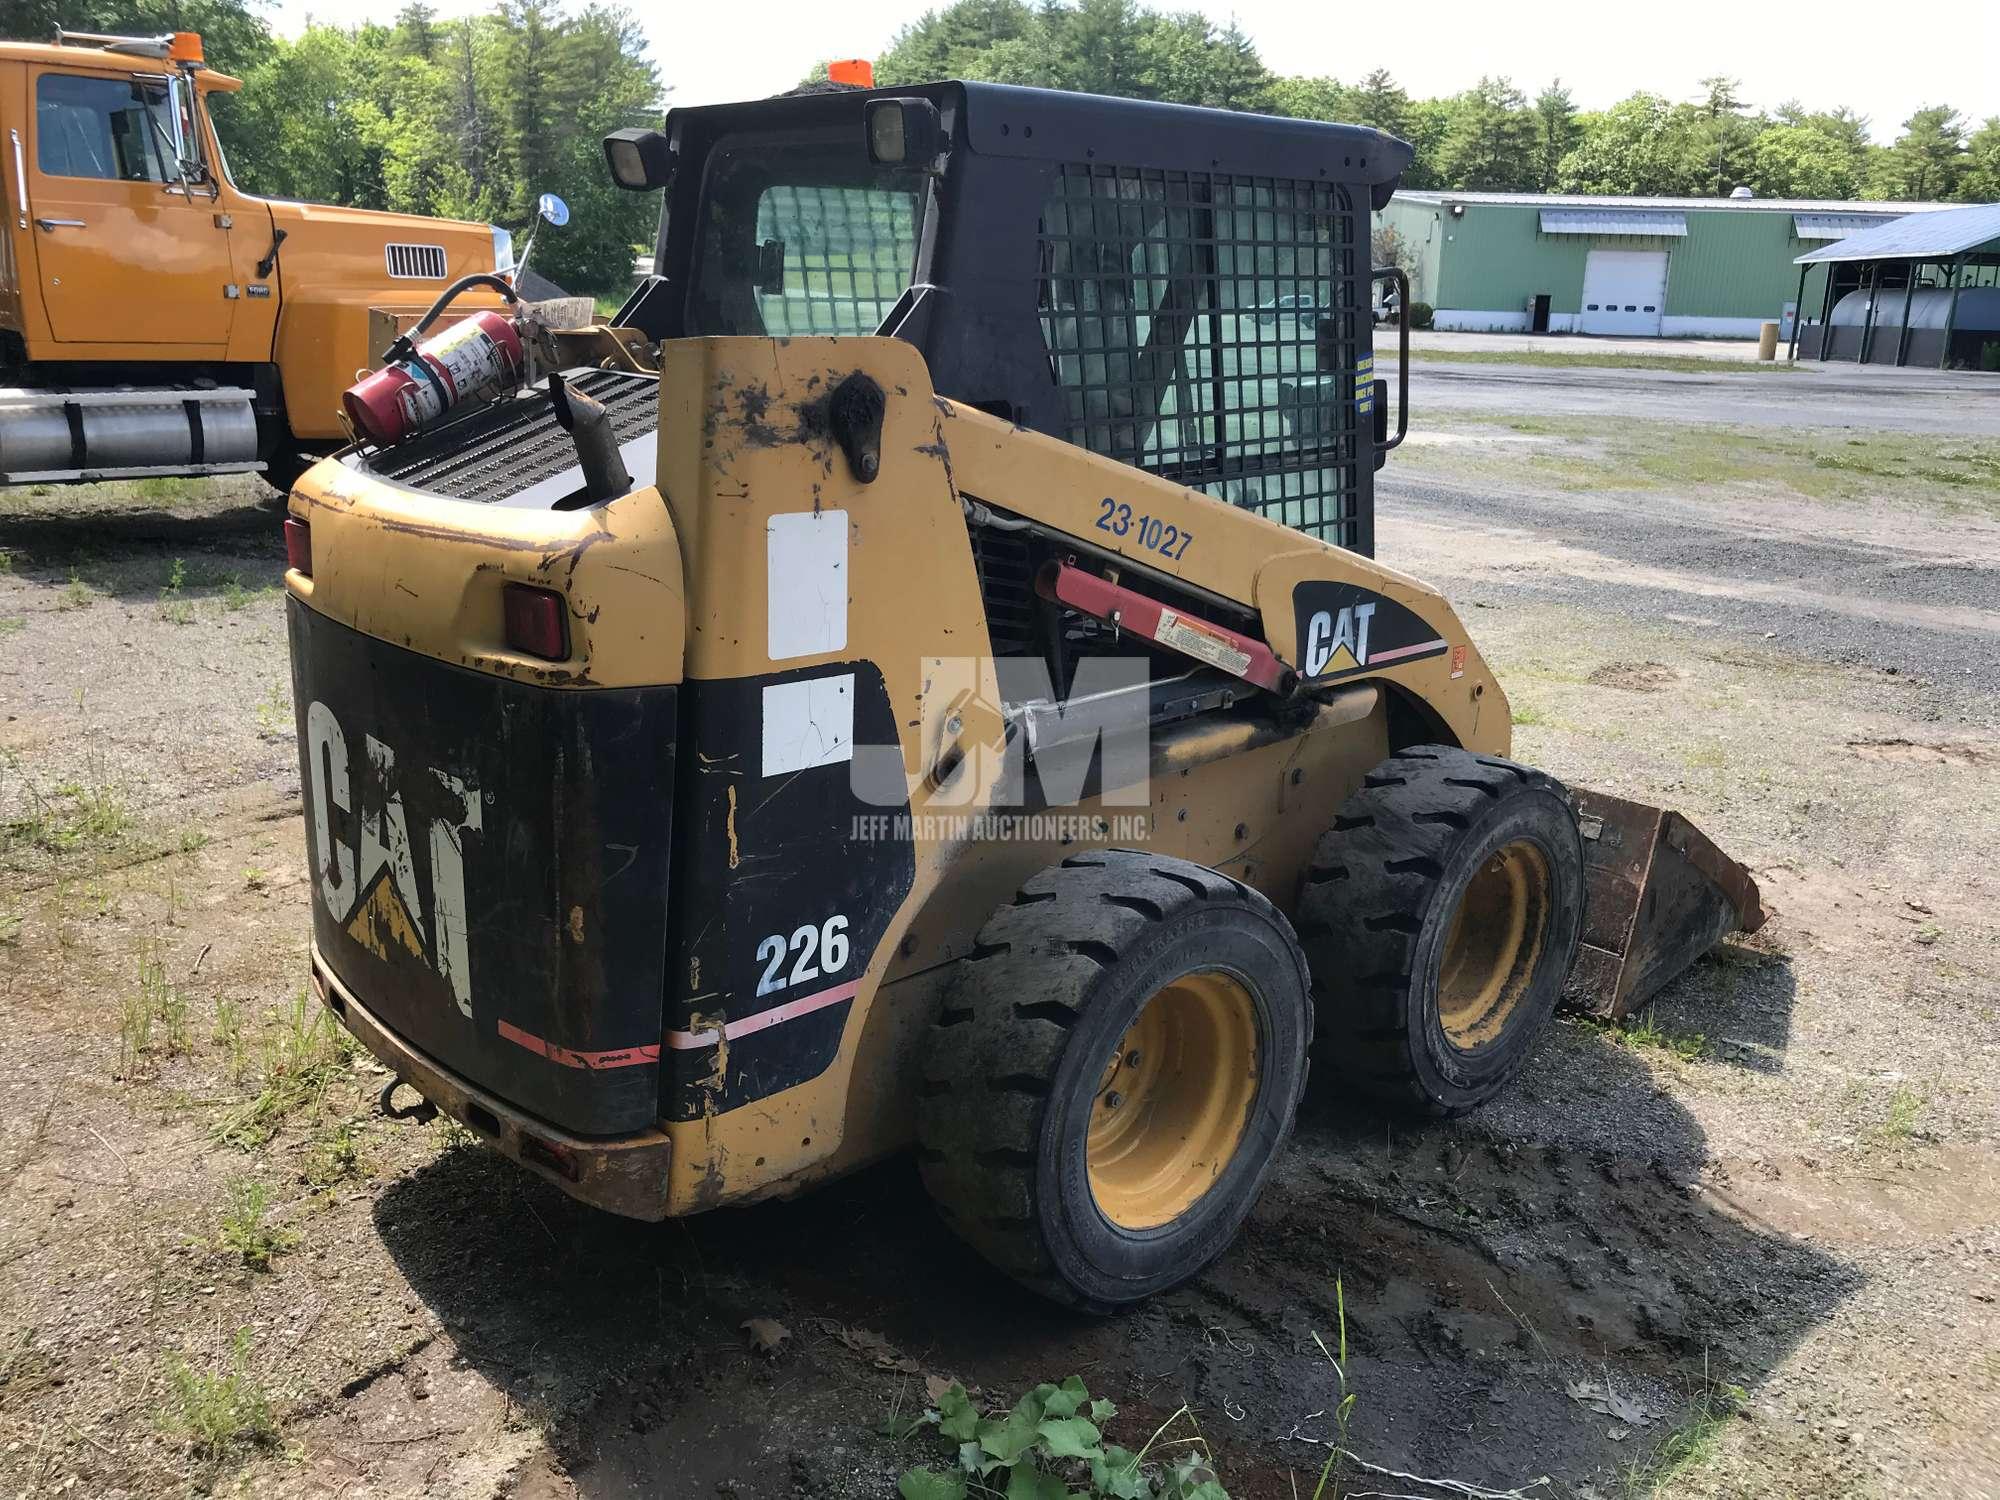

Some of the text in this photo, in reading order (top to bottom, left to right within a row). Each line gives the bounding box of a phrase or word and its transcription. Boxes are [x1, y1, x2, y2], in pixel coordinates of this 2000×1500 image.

[1305, 602, 1376, 678] CAT
[308, 700, 484, 1020] CAT
[756, 914, 850, 998] 226
